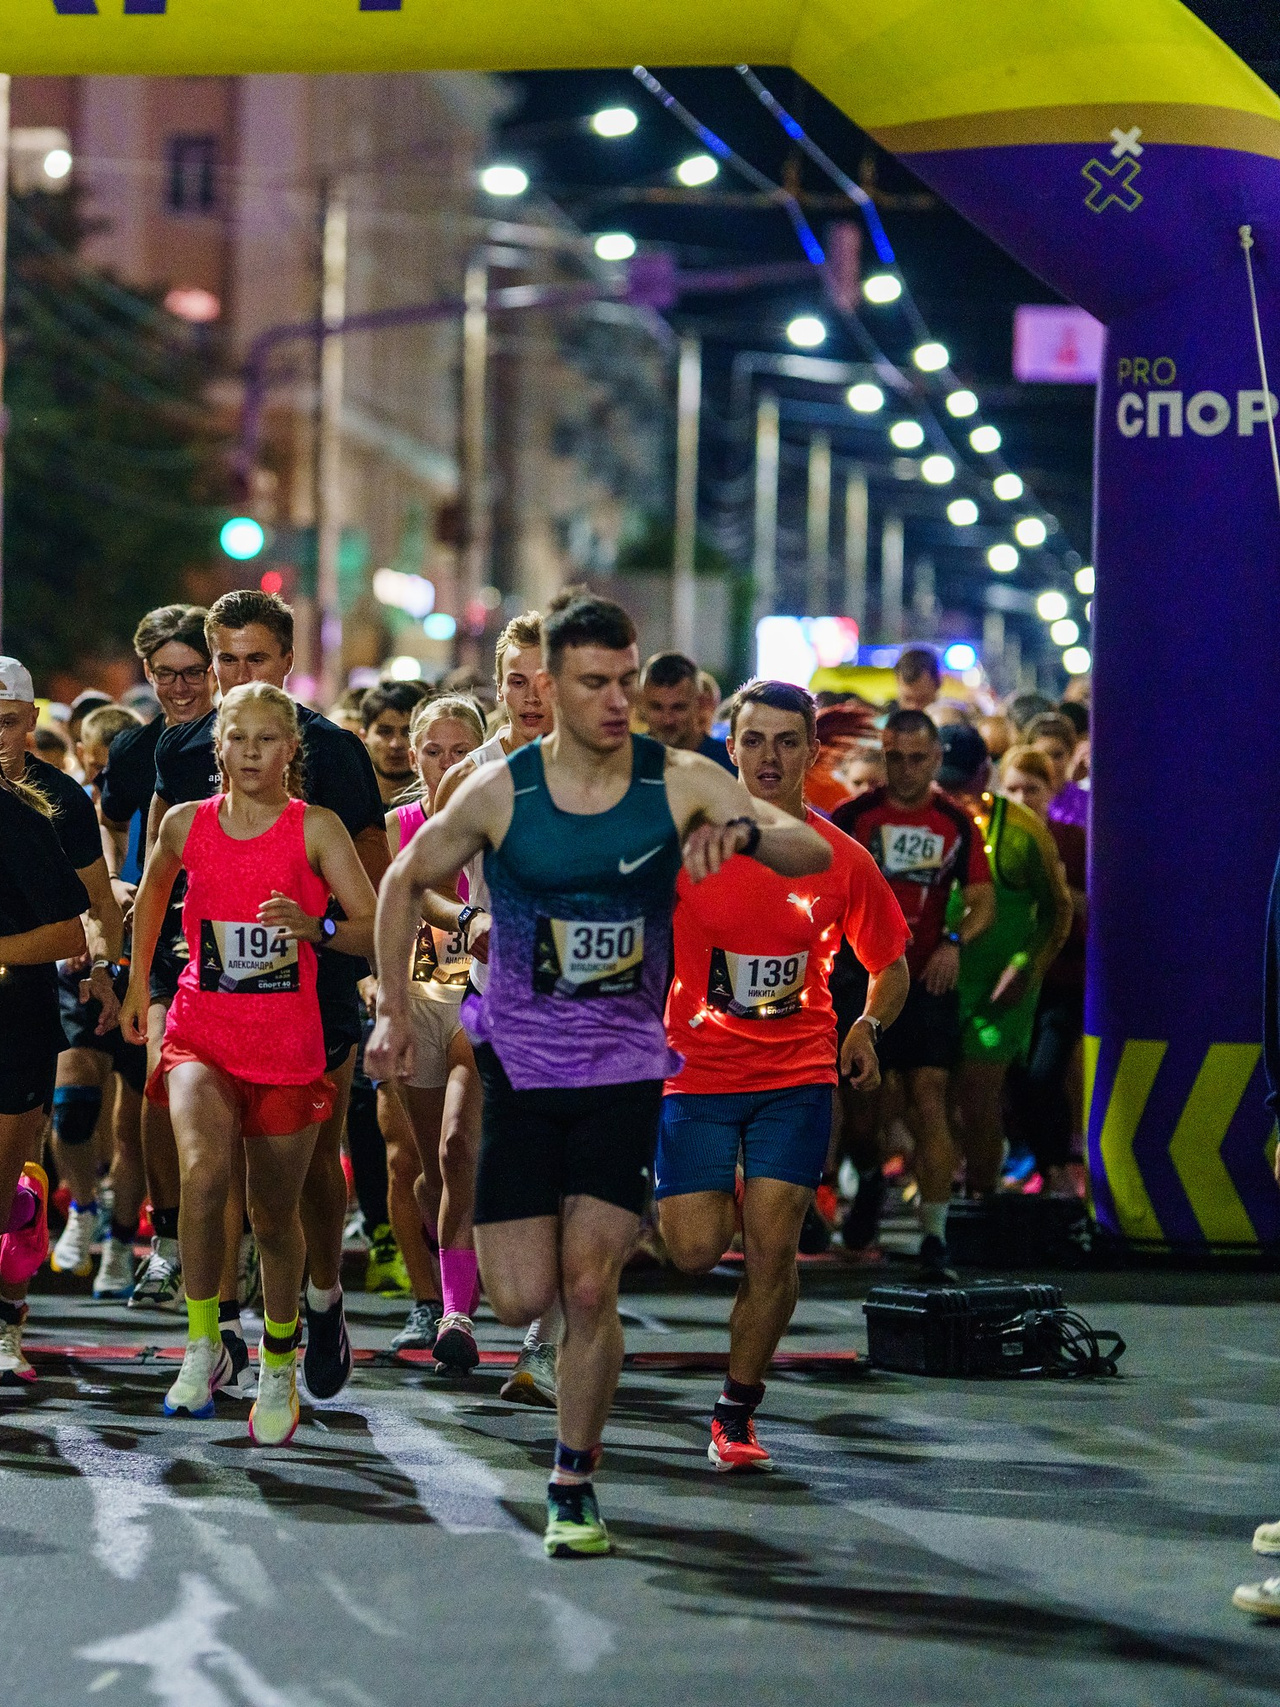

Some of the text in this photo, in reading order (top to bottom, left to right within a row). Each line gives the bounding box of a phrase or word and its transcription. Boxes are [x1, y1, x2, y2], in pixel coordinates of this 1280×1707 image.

[1119, 356, 1177, 386] PRO
[893, 833, 936, 859] 426
[234, 926, 289, 959] 194
[573, 926, 635, 960] 350
[228, 960, 274, 971] АЛЕКСАНДРА
[747, 957, 799, 988] 139
[748, 989, 776, 998] НИКИТА
